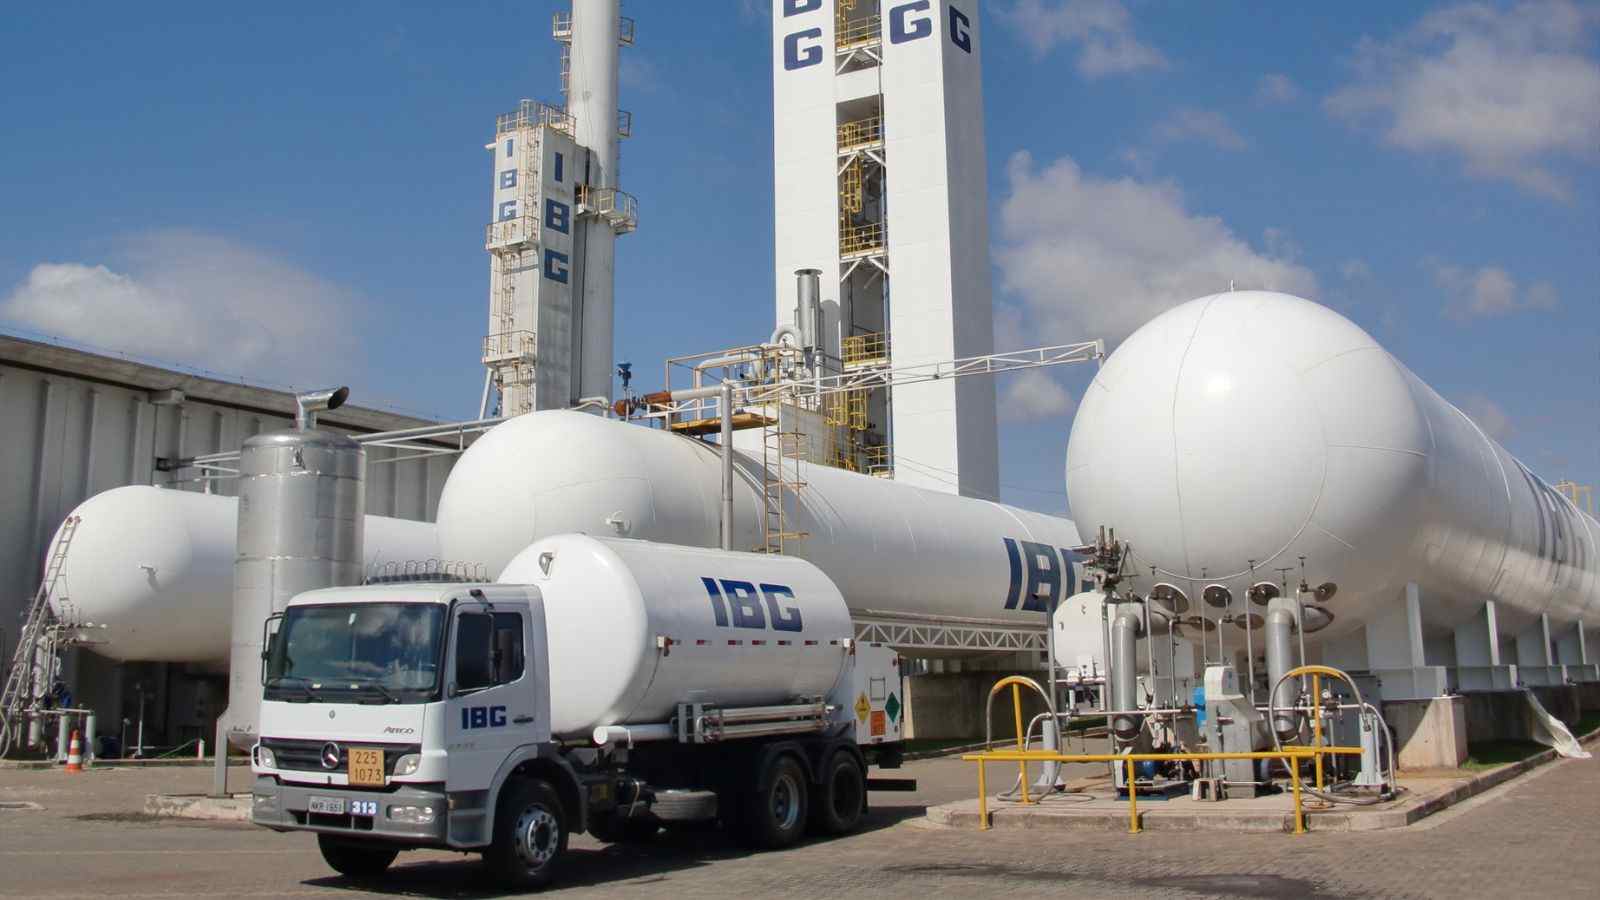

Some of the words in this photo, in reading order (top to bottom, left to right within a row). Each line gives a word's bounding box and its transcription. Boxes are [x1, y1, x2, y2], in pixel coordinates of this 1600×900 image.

[544, 151, 570, 284] IBG
[701, 576, 803, 632] IBG
[462, 706, 506, 729] IBG
[355, 751, 377, 765] 225
[355, 768, 381, 782] 1073
[352, 801, 377, 815] 313
